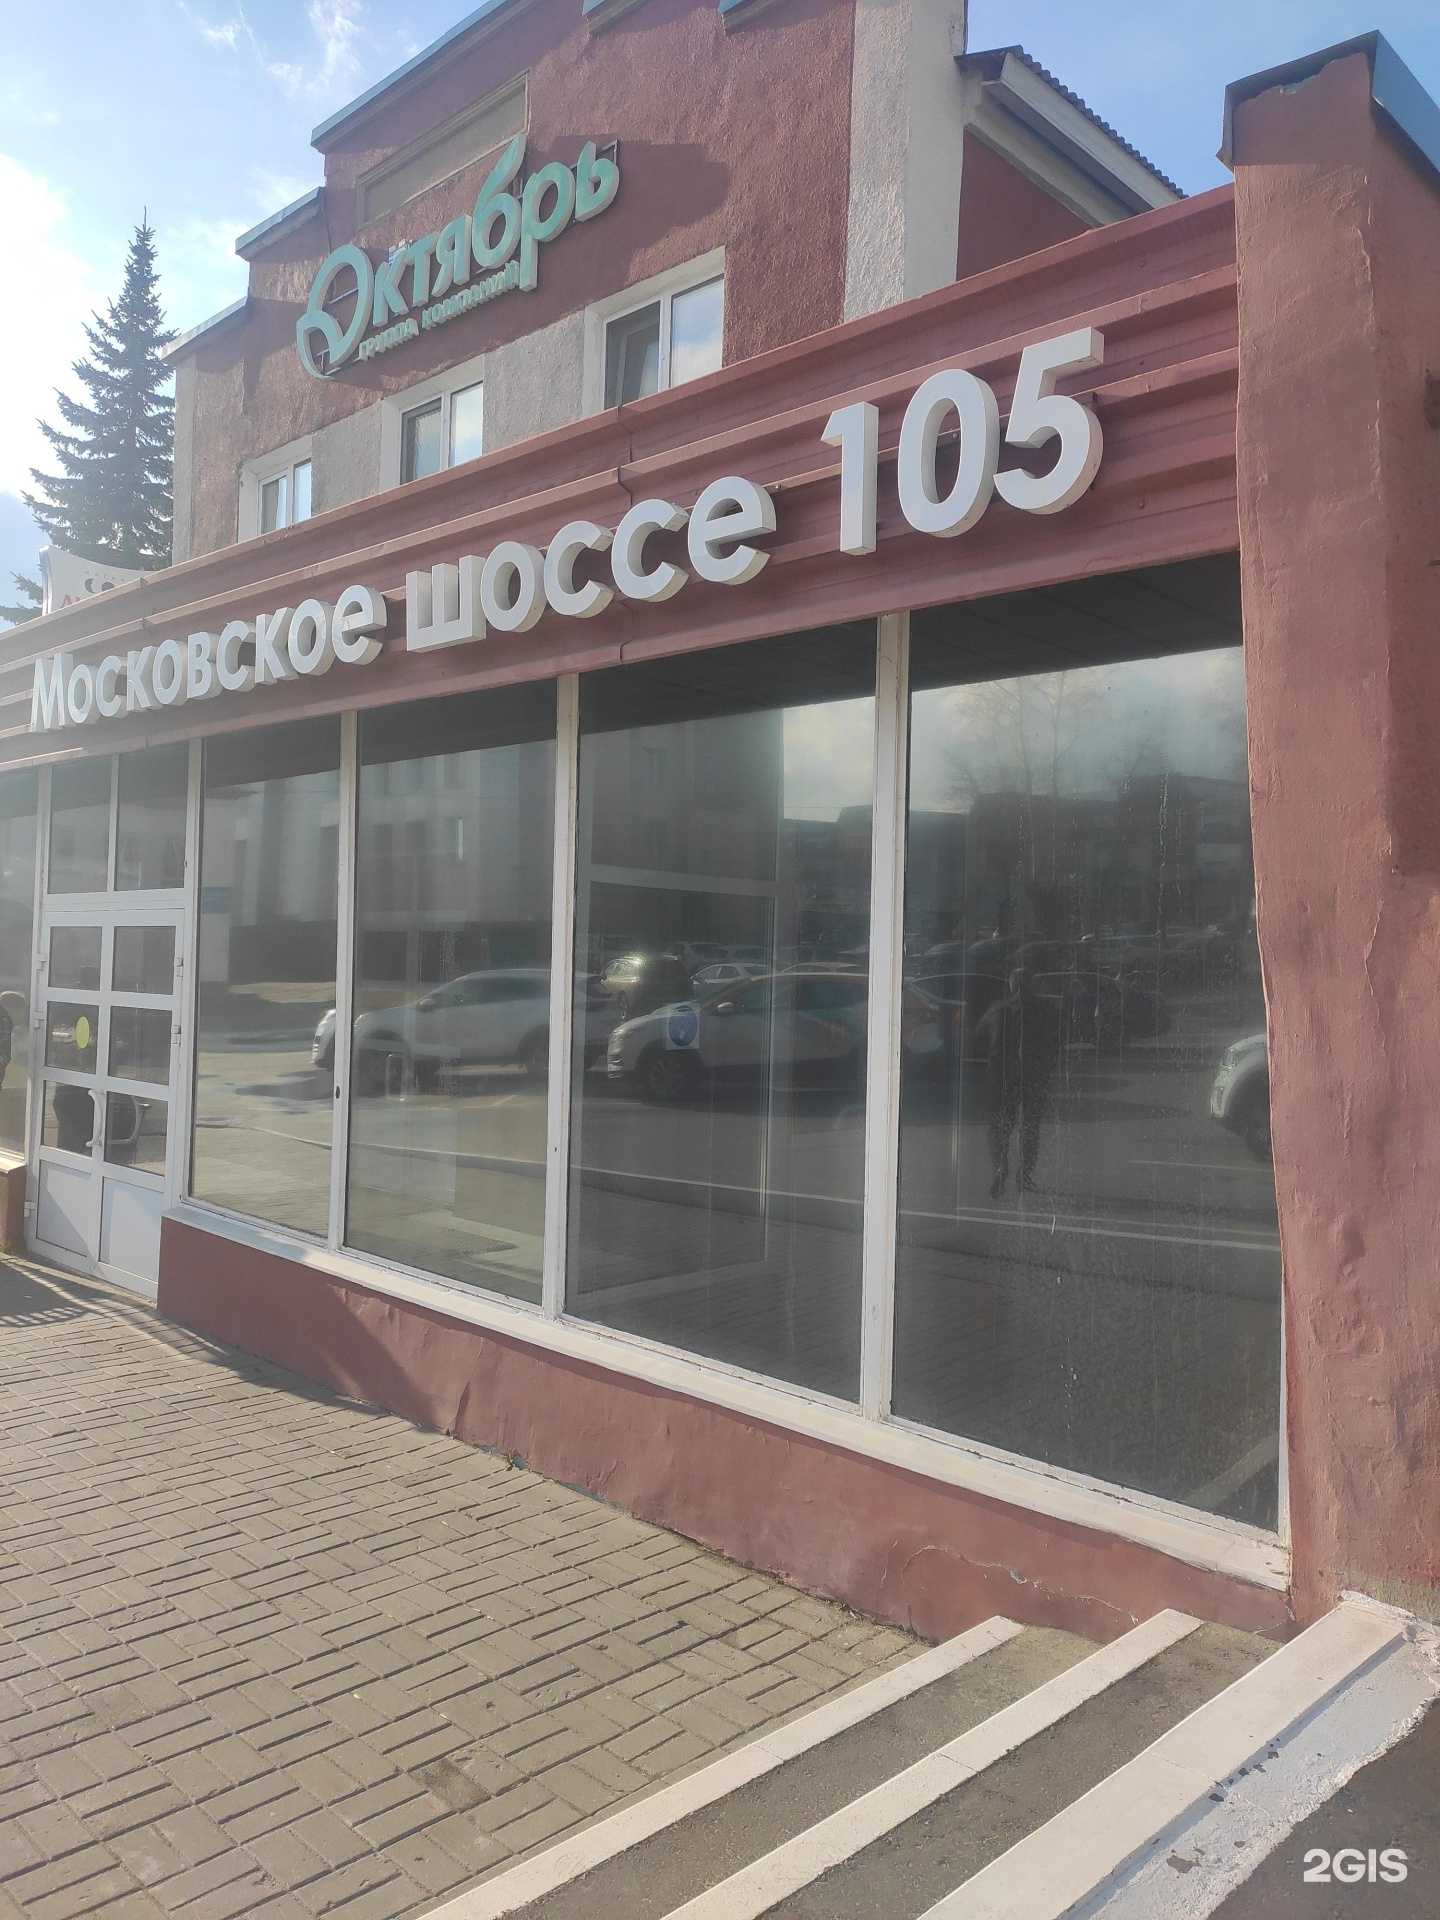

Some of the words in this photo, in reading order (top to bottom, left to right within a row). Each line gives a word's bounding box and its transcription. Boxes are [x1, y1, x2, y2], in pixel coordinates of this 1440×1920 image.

[297, 129, 620, 380] Октябрь
[30, 584, 387, 732] Московское
[406, 476, 776, 652] шоссе
[820, 327, 1104, 555] 105
